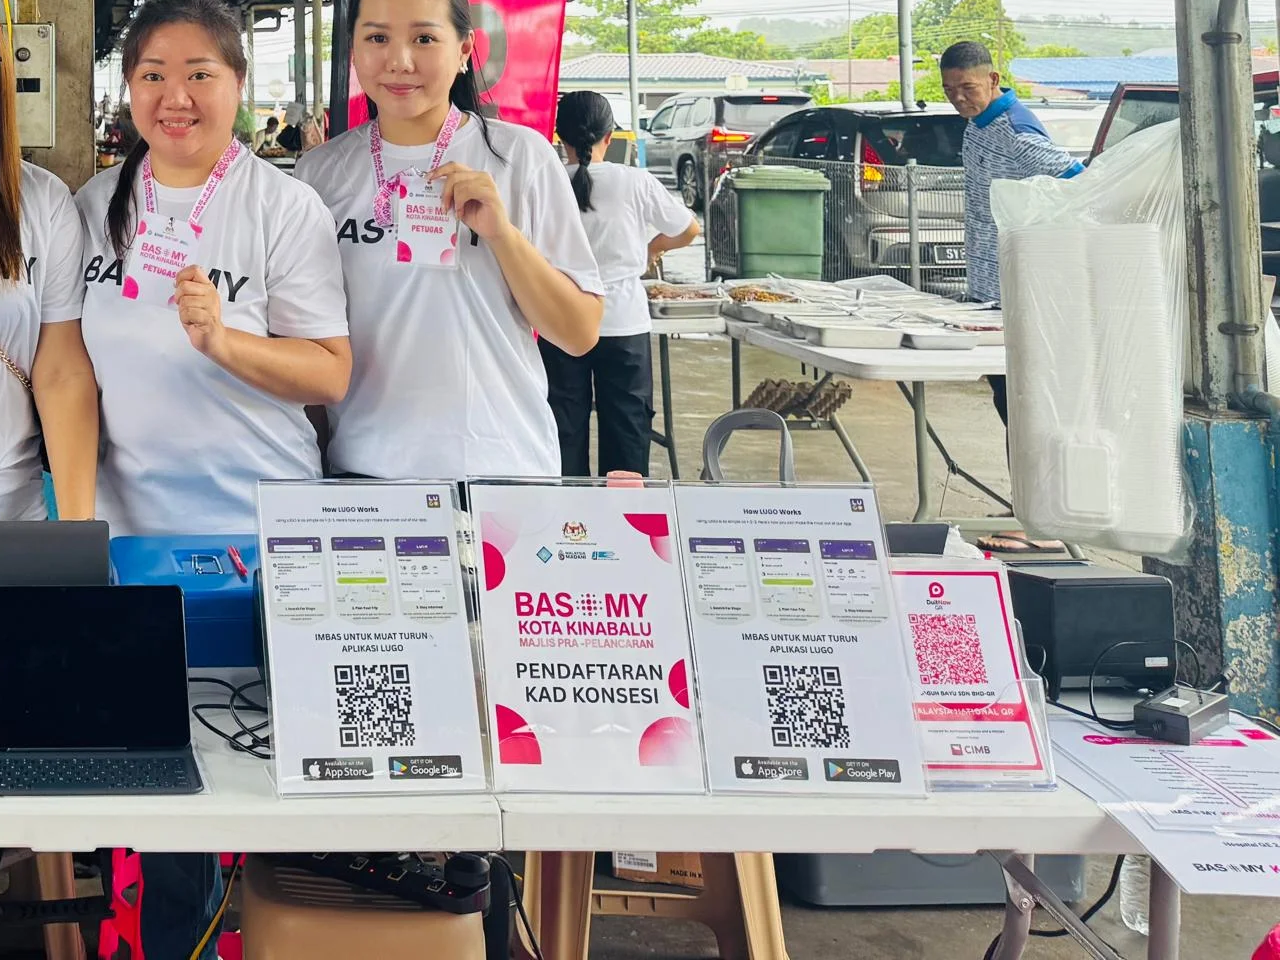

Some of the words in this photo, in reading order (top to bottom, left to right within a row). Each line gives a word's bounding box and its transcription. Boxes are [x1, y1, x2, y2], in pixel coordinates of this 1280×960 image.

[406, 204, 425, 214] BAS
[336, 218, 386, 245] AS
[411, 224, 444, 234] PETUGAS
[141, 242, 162, 255] BAS
[171, 251, 188, 262] MY
[84, 254, 123, 286] BA
[143, 263, 177, 278] PETUGAS
[514, 592, 574, 617] BAS
[604, 593, 648, 618] MY
[518, 620, 562, 635] KOTA
[566, 621, 652, 637] KINABALU
[315, 633, 342, 641] IMBAS
[343, 633, 373, 641] UNTUK
[399, 632, 428, 640] TURUN
[742, 633, 769, 641] IMBAS
[771, 633, 801, 642] UNTUK
[802, 634, 826, 642] MUAT
[828, 634, 858, 643] TURUN
[380, 644, 404, 652] LUGO
[519, 638, 556, 648] MAJLIS
[558, 638, 579, 648] PRA
[770, 646, 808, 654] APLIKASI
[809, 646, 834, 654] LUGO
[516, 662, 663, 680] PENDAFTARAN
[526, 686, 567, 703] KAD
[573, 687, 659, 704] KONSESI
[1001, 708, 1014, 716] QR
[965, 745, 991, 754] CIMB
[324, 768, 342, 778] App
[344, 767, 367, 776] Store
[411, 765, 440, 777] Google
[441, 766, 458, 775] Play
[758, 767, 777, 777] App
[779, 767, 803, 777] Store
[847, 768, 878, 779] Google
[879, 769, 896, 779] Play
[670, 868, 688, 877] MADE
[1192, 862, 1228, 872] BAS
[1242, 863, 1265, 873] MY
